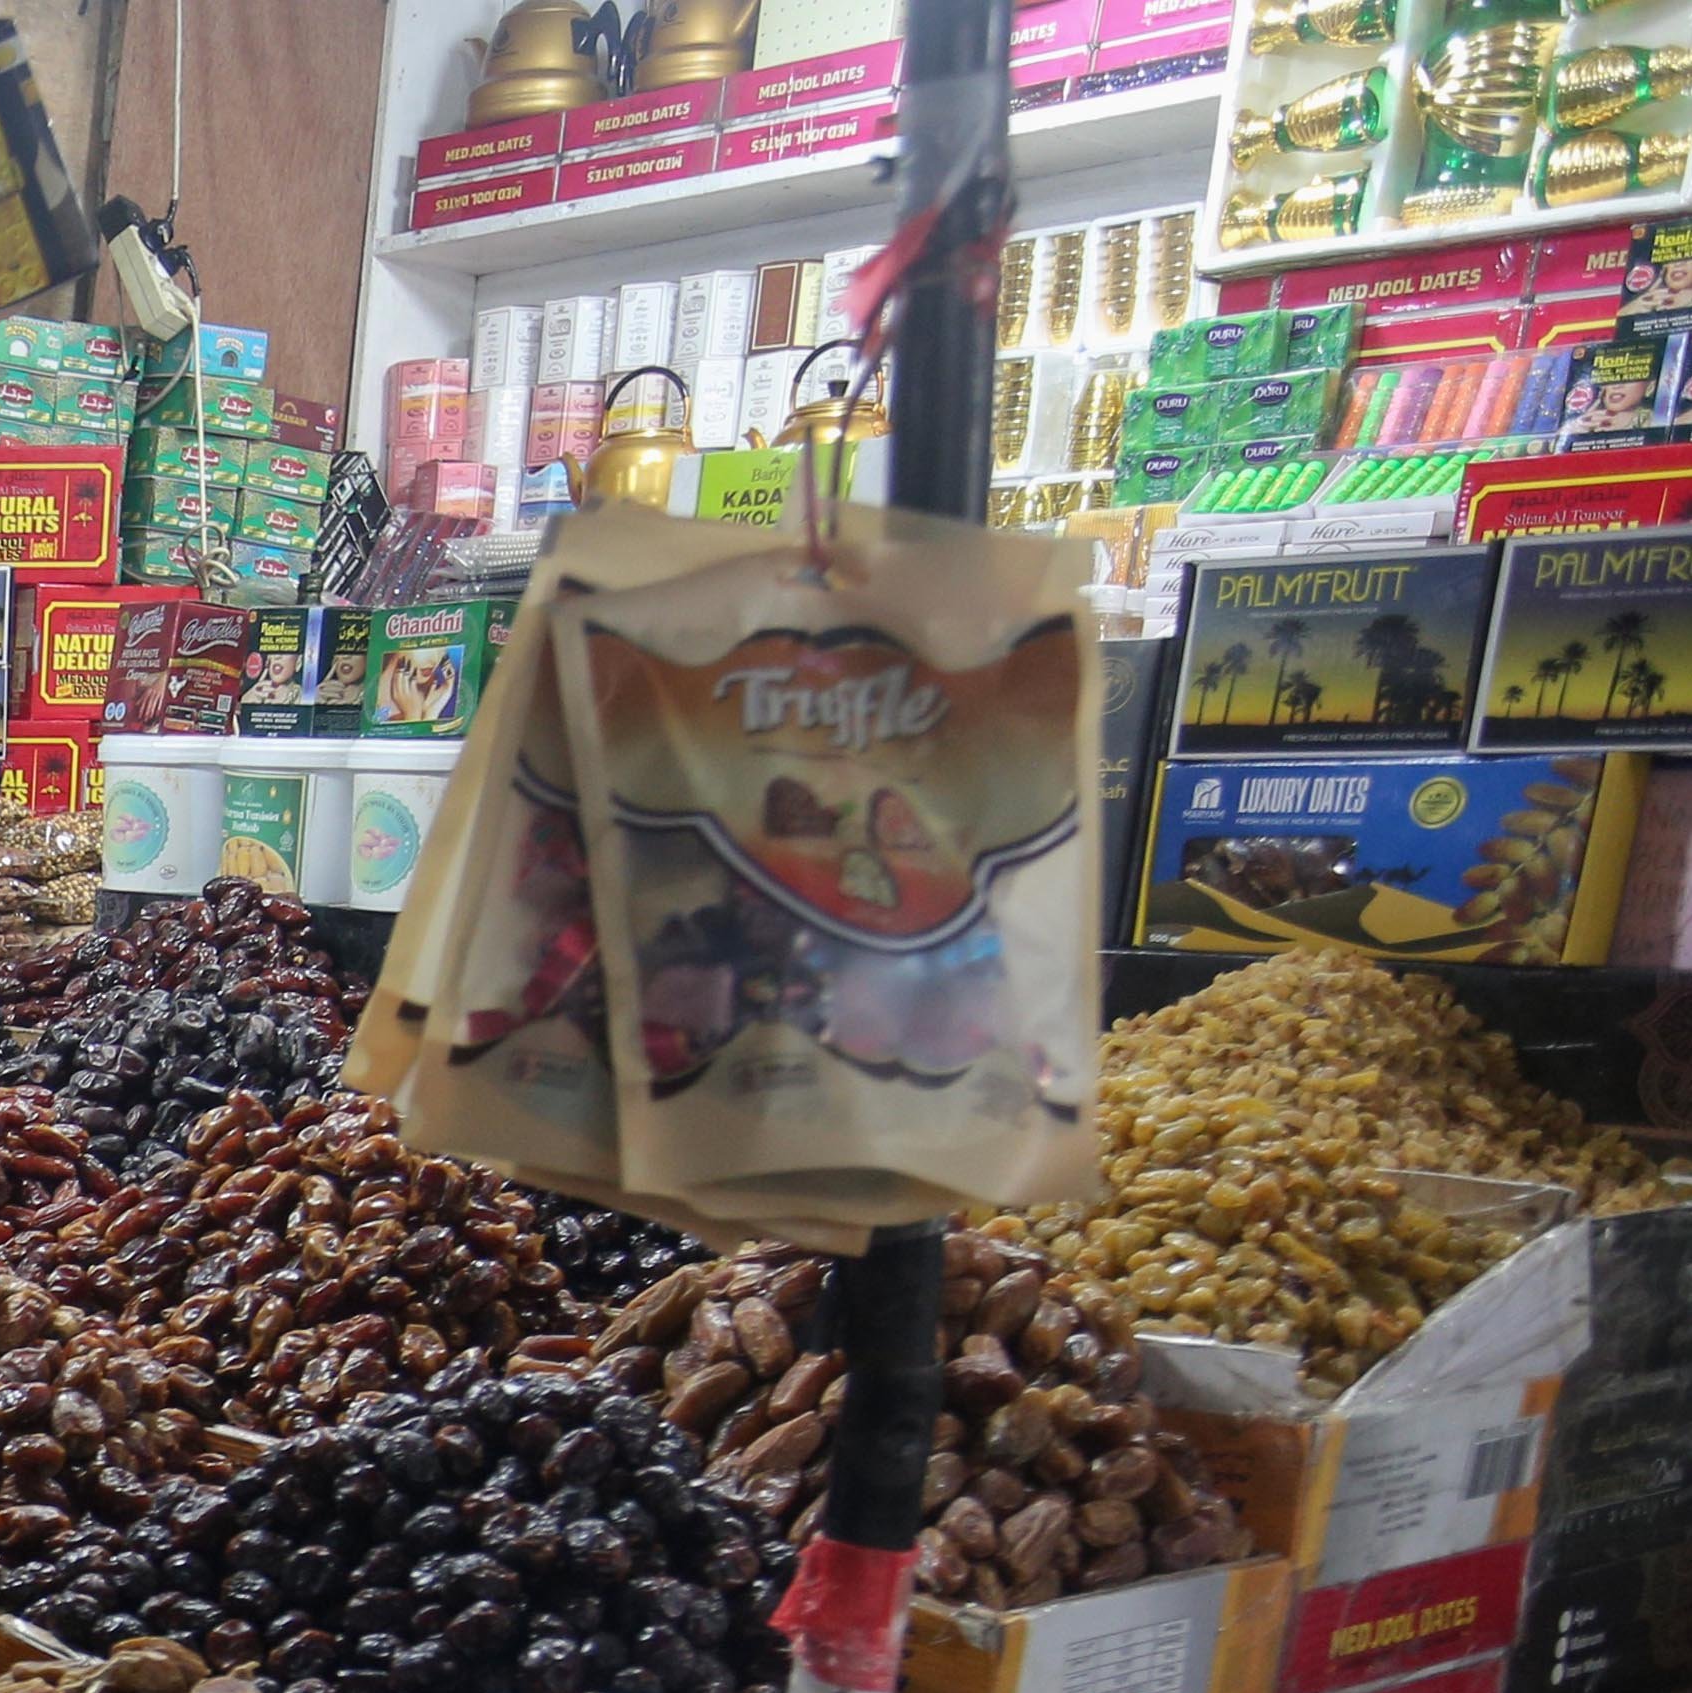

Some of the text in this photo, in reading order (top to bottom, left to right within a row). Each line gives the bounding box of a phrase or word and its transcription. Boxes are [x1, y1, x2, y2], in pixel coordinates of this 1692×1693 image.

[1010, 22, 1057, 46] DATES
[758, 65, 866, 100] MEDJOOL DATES
[594, 102, 691, 134] MEDJOOL DATES
[444, 134, 533, 163] MEDJOOL DATES
[586, 154, 683, 184] MEDJOOL DATES
[435, 185, 523, 213] MEDJOOL DATES
[1327, 267, 1482, 303] MEDJOOL DATES
[1207, 326, 1241, 340] DURU
[1155, 396, 1189, 410] DURU
[1254, 384, 1290, 399] DURU
[1145, 459, 1179, 472] DURU
[1245, 445, 1279, 459] DURU
[1503, 507, 1626, 528] Sultan Al Tomoor
[1535, 545, 1692, 588] PALM'FR
[1216, 566, 1414, 608] PALM'FRUTT
[385, 608, 464, 640] Chandni
[53, 634, 115, 652] NATU
[53, 652, 112, 671] DELIG
[56, 674, 109, 687] MEDJOO
[714, 666, 948, 749] Truffle
[1238, 776, 1370, 815] LUXURY DATES
[1329, 1596, 1478, 1660] MEDJOOL DATES
